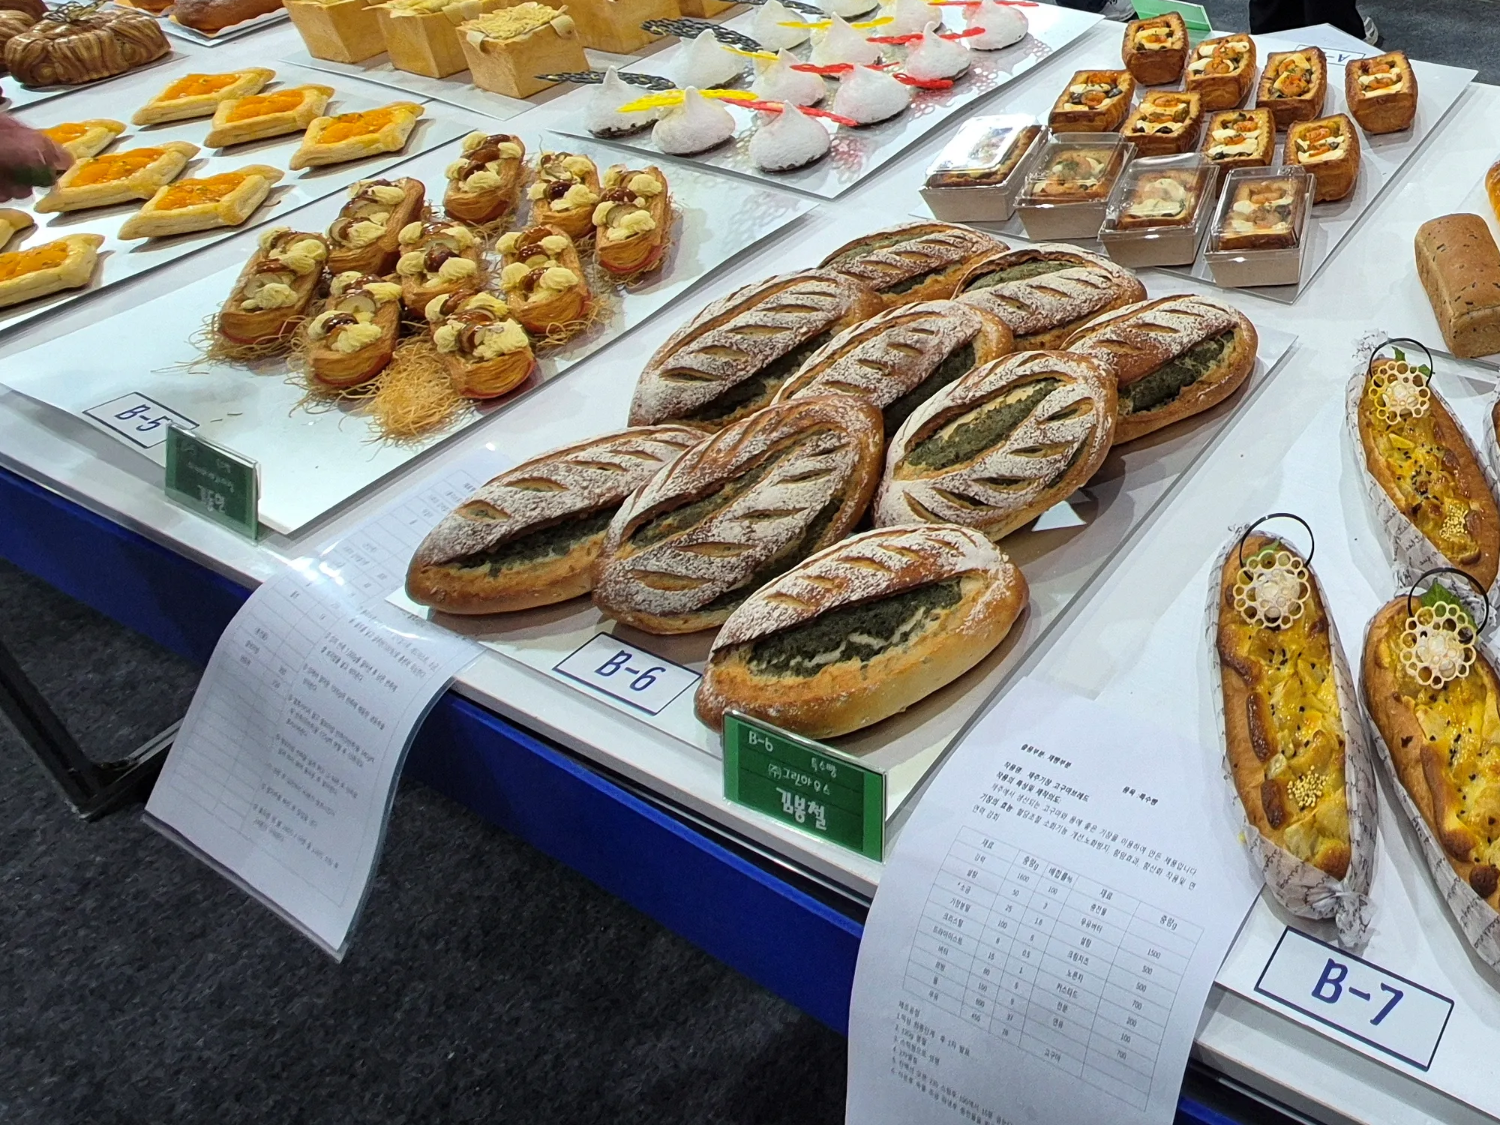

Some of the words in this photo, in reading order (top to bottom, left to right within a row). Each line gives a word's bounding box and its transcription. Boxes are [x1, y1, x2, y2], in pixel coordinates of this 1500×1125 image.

[114, 404, 174, 432] B-5
[595, 650, 666, 691] B-6
[749, 731, 774, 752] B-6
[776, 787, 827, 831] 김봉철
[1048, 886, 1058, 895] 100
[1147, 948, 1161, 960] 1500
[1142, 965, 1153, 975] 500
[1135, 982, 1147, 992] 500
[1310, 957, 1405, 1028] B-7
[1132, 1000, 1142, 1010] 700
[1120, 1033, 1131, 1043] 100
[1116, 1050, 1127, 1060] 700
